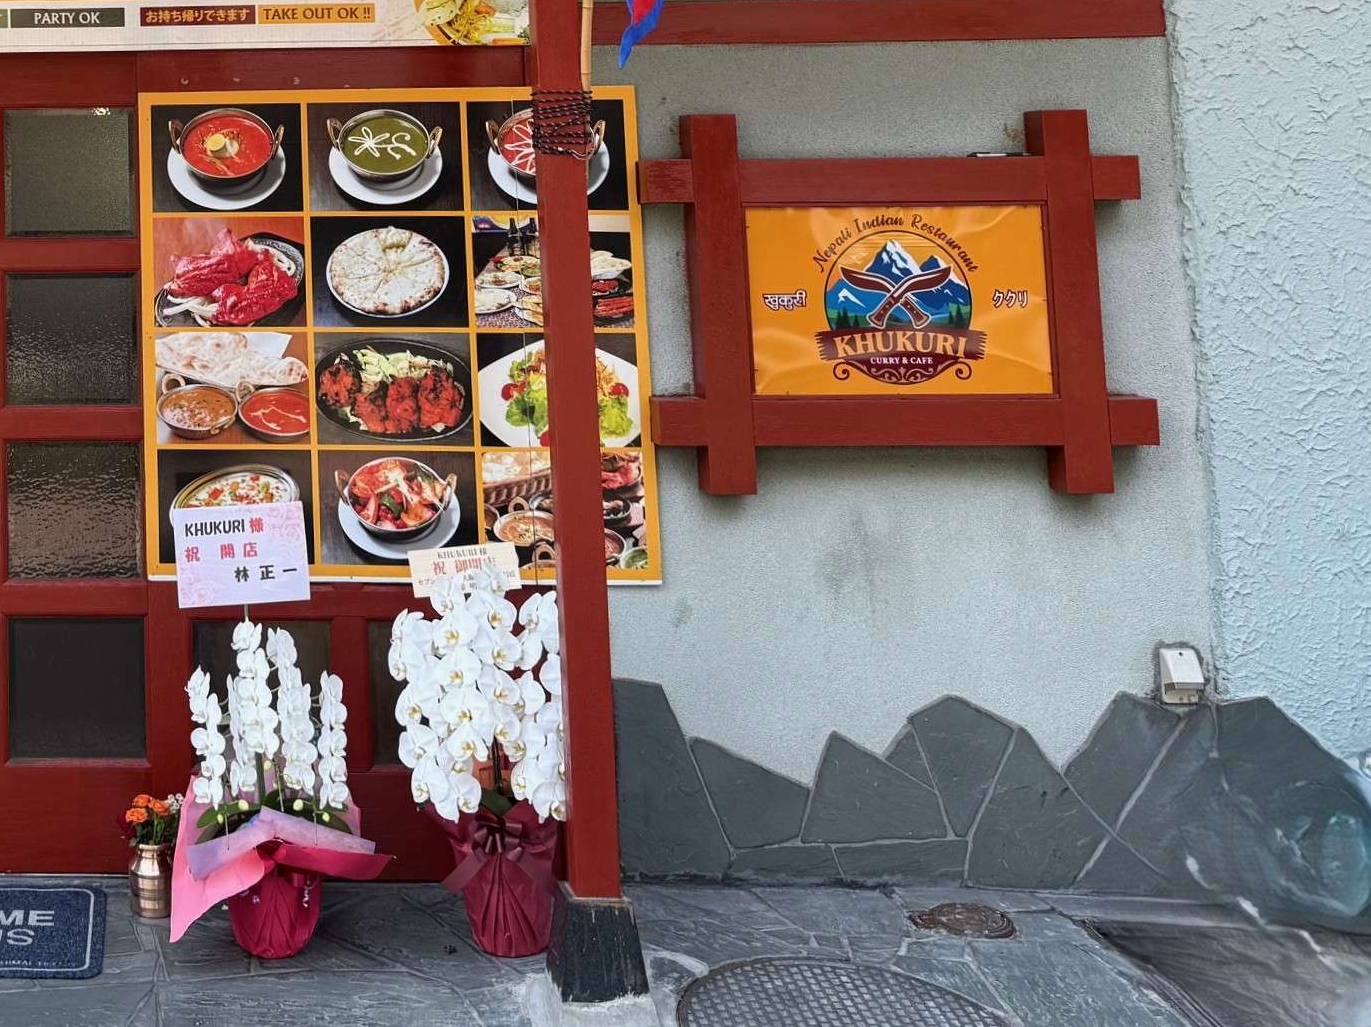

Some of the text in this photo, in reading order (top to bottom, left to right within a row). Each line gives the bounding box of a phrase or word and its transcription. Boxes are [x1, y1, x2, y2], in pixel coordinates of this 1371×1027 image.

[34, 12, 100, 24] PARTY OK
[145, 7, 250, 23] お持ち帰りできます
[263, 8, 298, 21] TAKE
[302, 7, 332, 20] OUT
[337, 7, 358, 20] OK
[812, 213, 979, 274] Nepali Indian Restaurant
[992, 289, 1030, 309] ククリ
[833, 330, 967, 359] KHUKURI
[870, 356, 934, 365] CURRY & CAFE
[184, 517, 264, 537] KHUKURI 様
[184, 546, 200, 562] 祝
